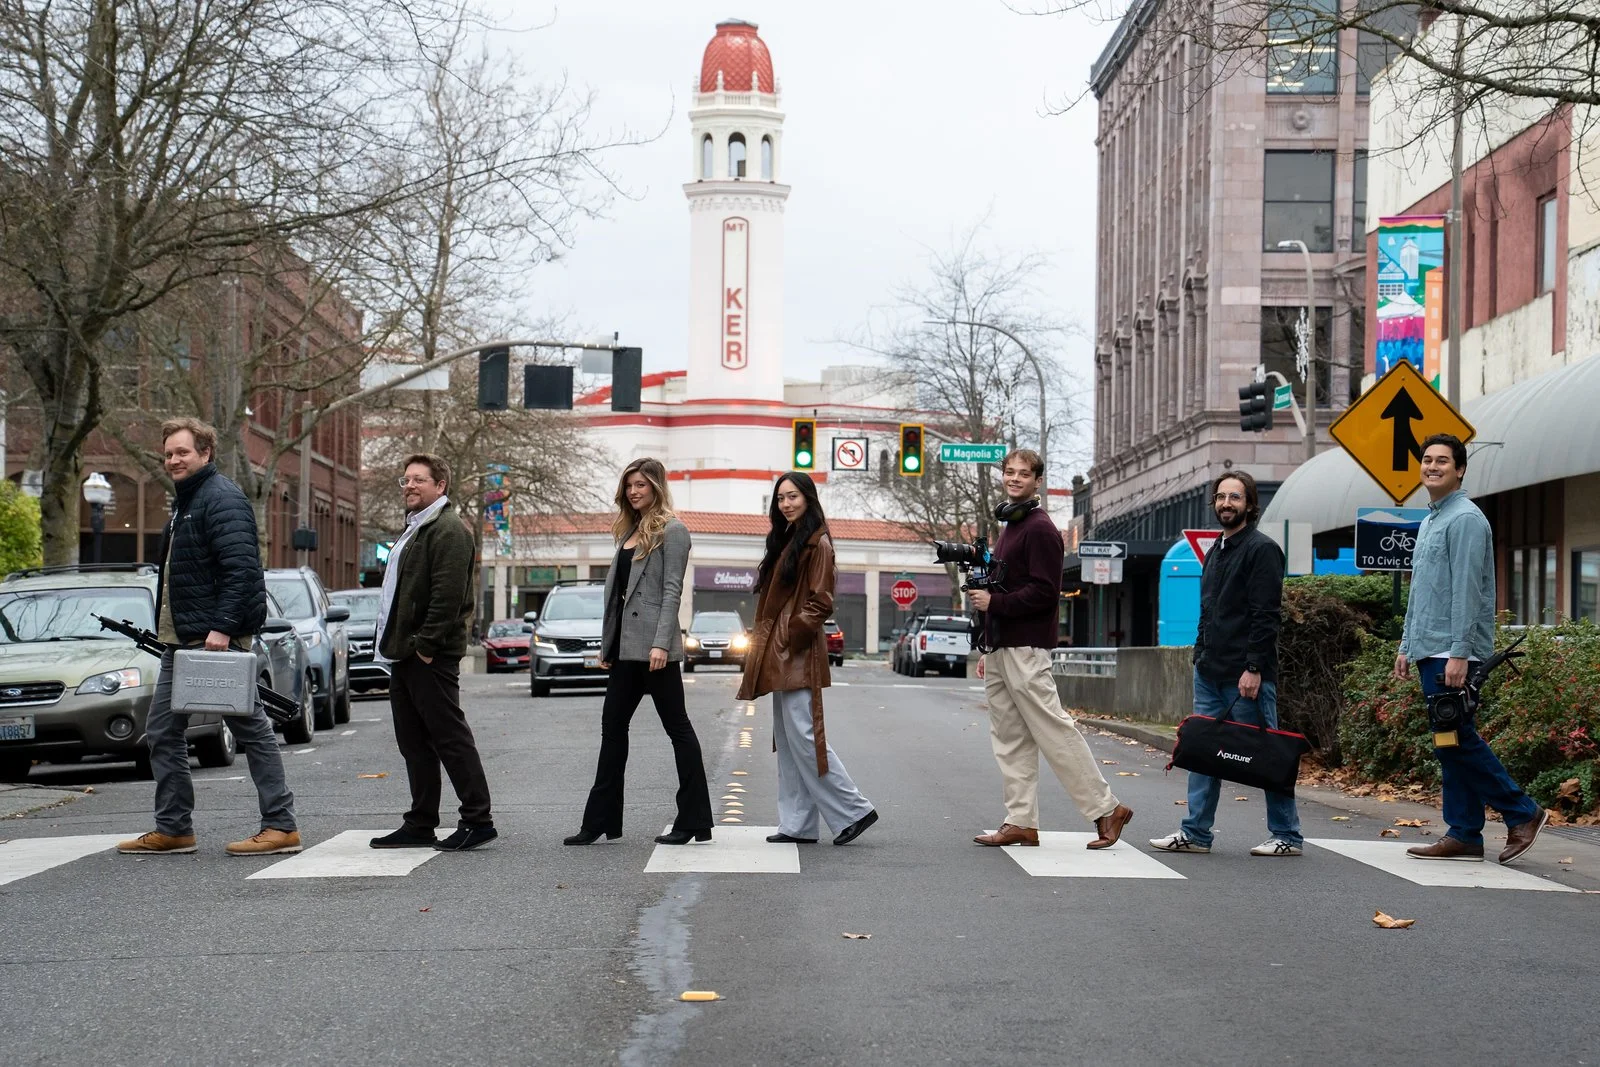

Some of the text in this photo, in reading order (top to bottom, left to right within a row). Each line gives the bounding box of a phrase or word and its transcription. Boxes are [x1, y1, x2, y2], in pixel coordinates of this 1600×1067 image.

[725, 223, 745, 231] MT
[943, 448, 1003, 460] W Magnolia St
[1362, 555, 1375, 565] TO
[1377, 556, 1401, 566] Civic
[893, 587, 916, 598] STOP
[185, 676, 237, 689] amaran
[0, 724, 32, 738] T8857
[1216, 749, 1251, 763] Aputure
